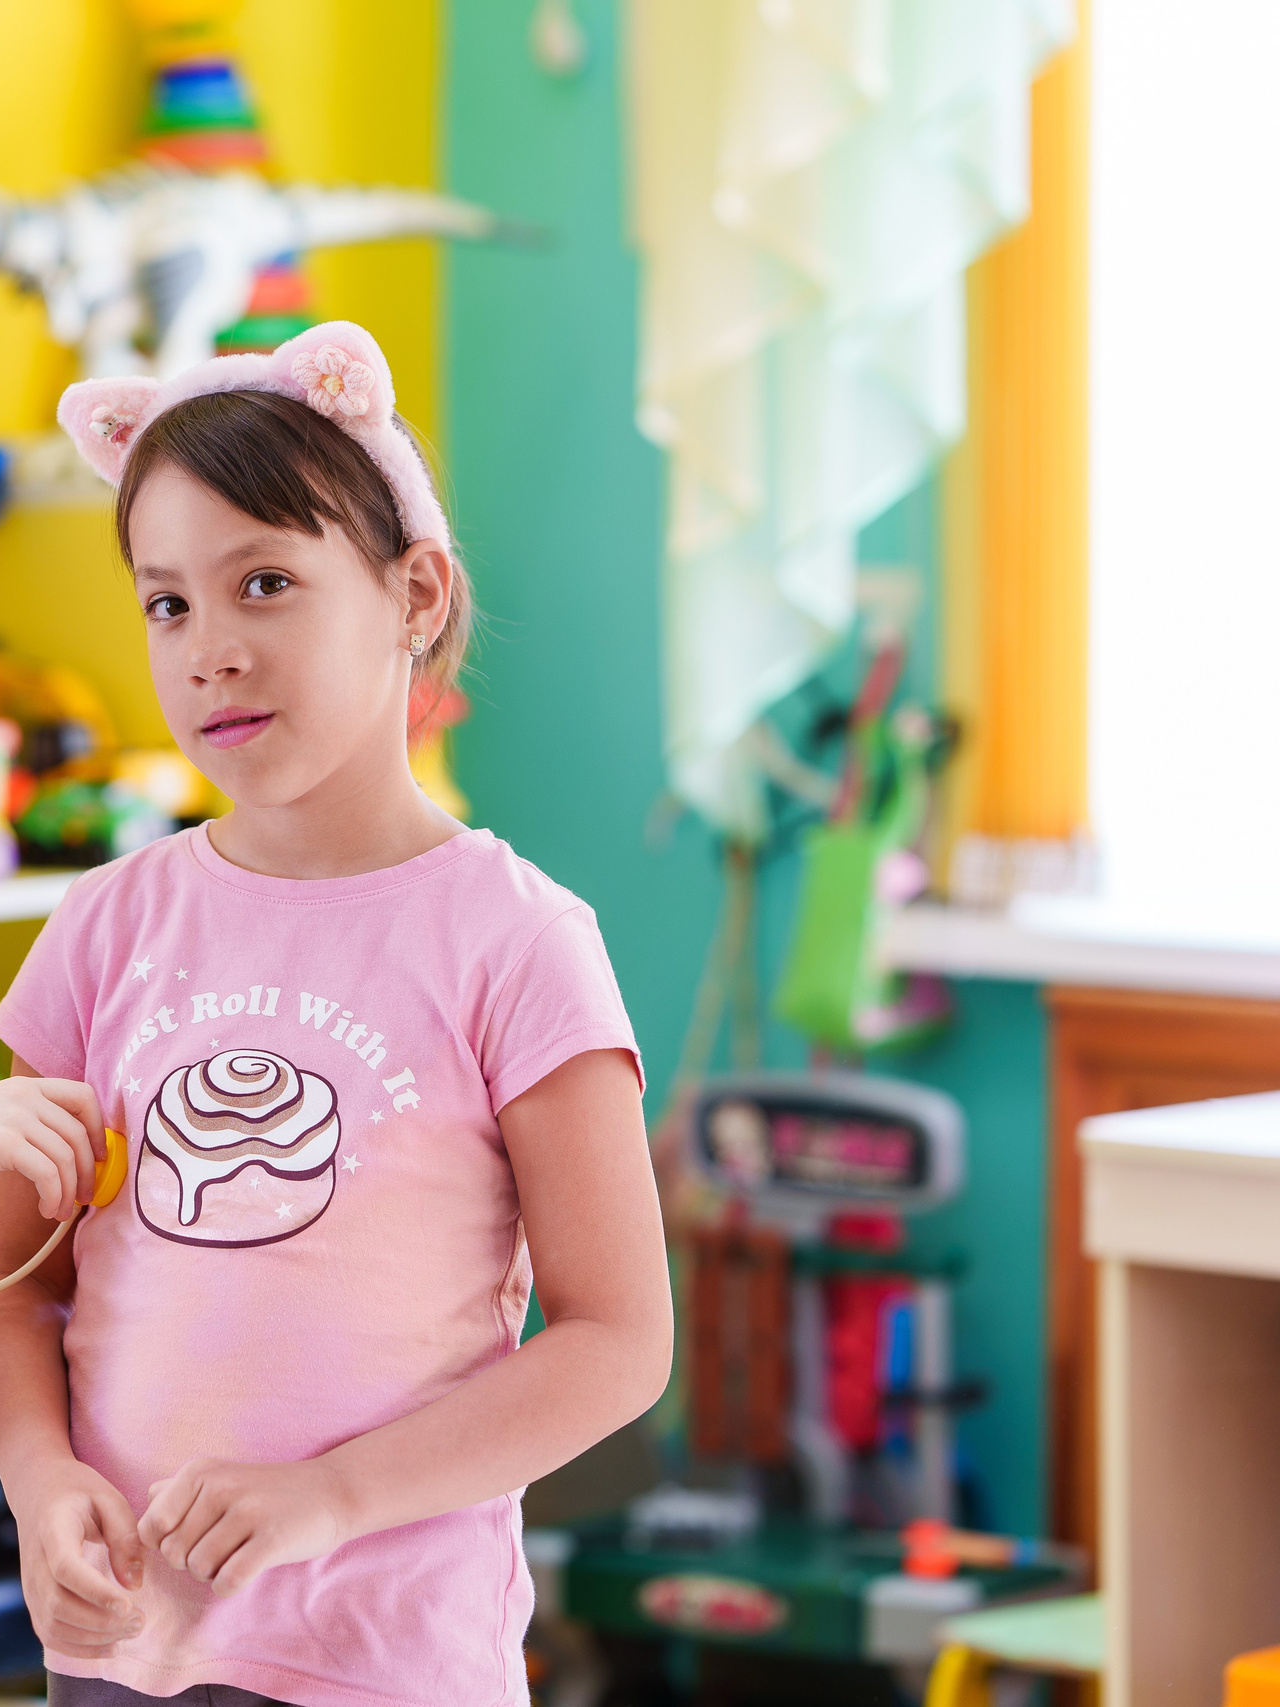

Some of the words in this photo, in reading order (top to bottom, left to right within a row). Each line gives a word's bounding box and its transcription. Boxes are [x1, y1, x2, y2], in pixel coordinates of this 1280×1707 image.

[190, 985, 281, 1024] Roll
[299, 991, 387, 1070] With
[381, 1066, 421, 1114] It
